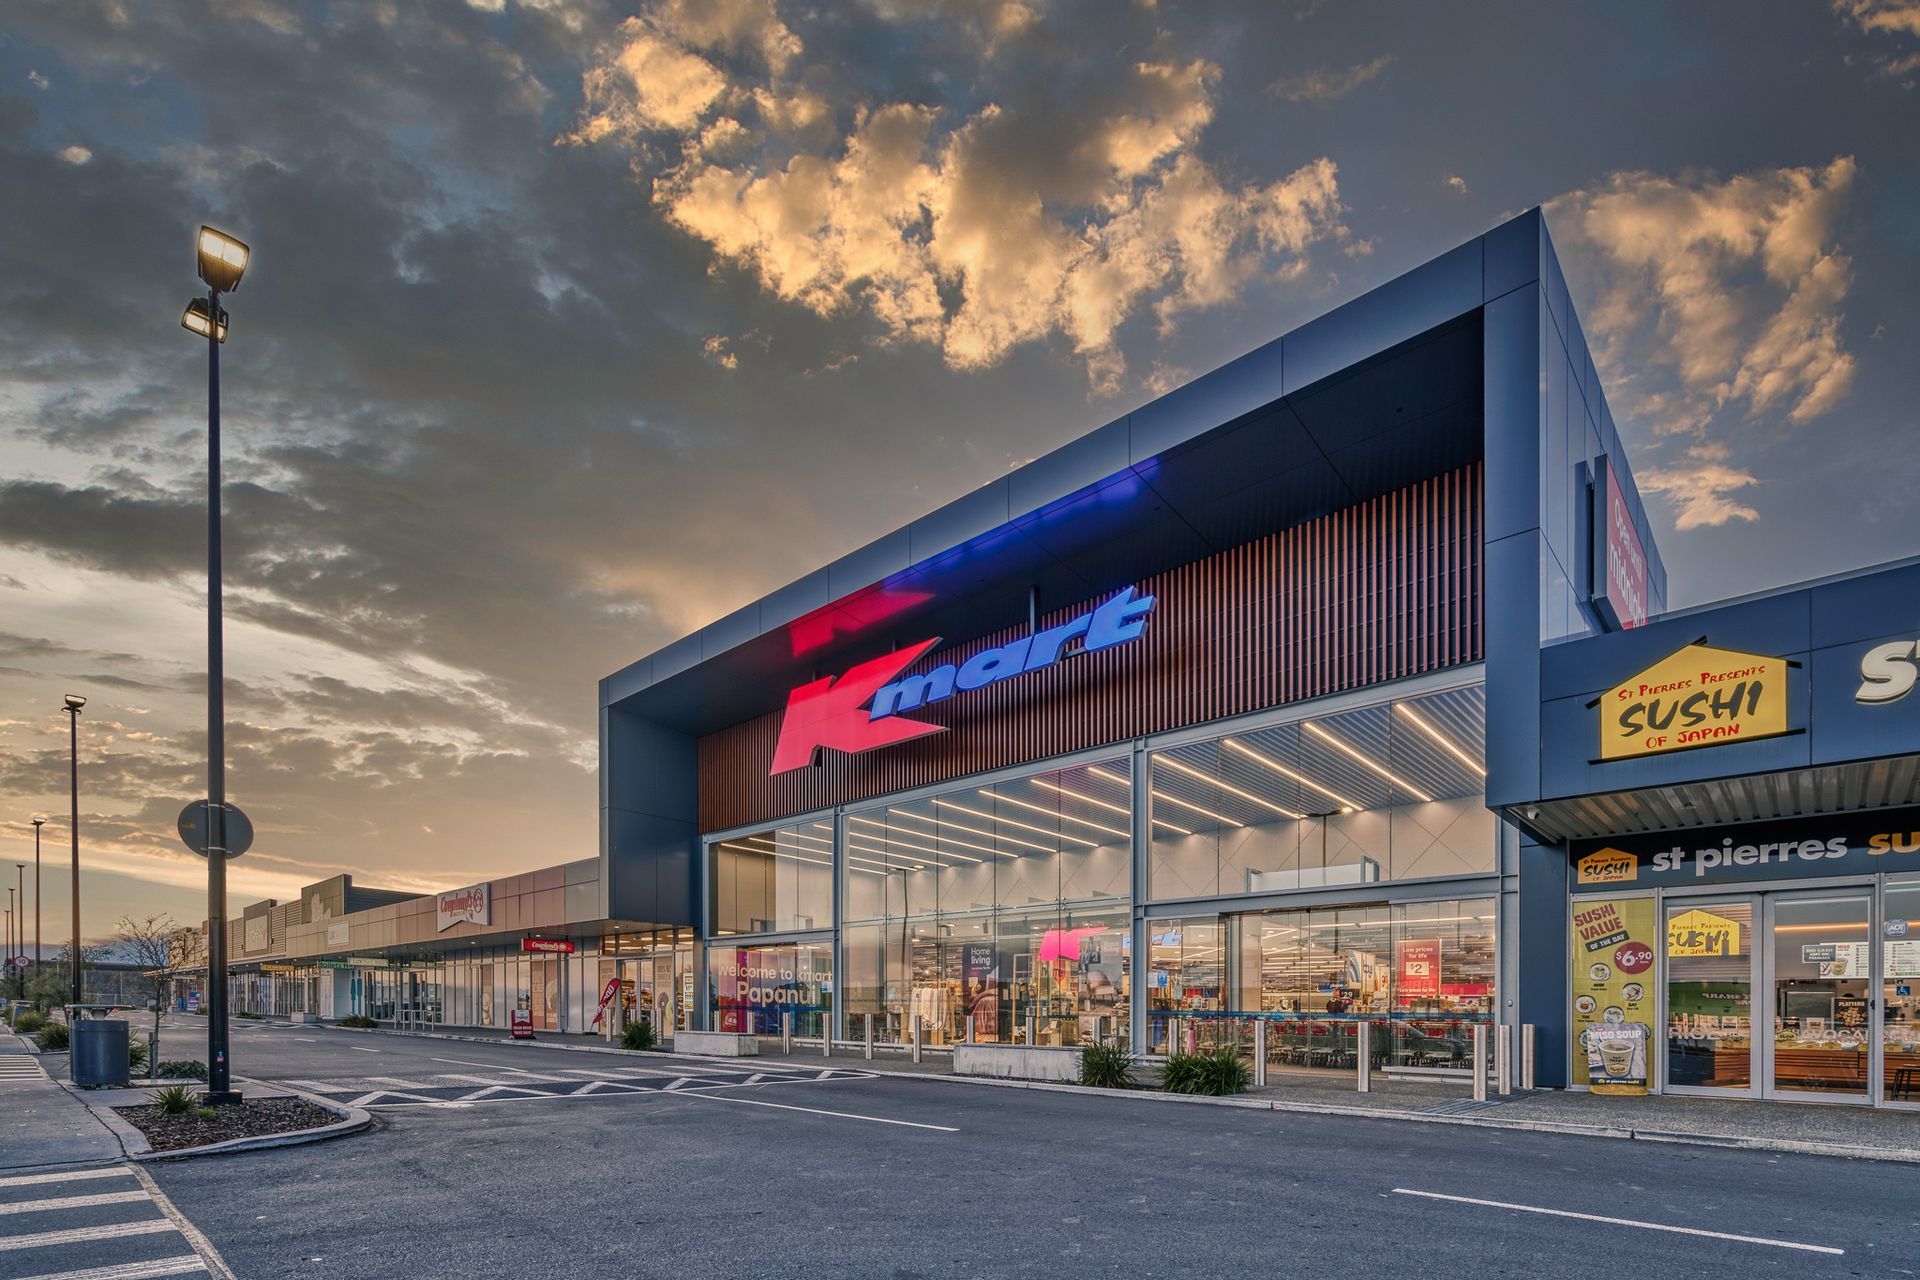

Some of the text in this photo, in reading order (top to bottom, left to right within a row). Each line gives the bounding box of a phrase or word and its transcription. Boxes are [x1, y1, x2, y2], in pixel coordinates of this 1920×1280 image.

[1614, 499, 1642, 582] Open until
[1610, 542, 1645, 628] midnight
[770, 585, 1157, 776] Kmart
[1856, 640, 1920, 704] S
[1619, 680, 1763, 737] SUSHI
[1646, 724, 1740, 749] OF JAPAN
[1652, 846, 1685, 872] st
[1695, 837, 1847, 877] pierres
[1583, 862, 1630, 877] SUSHI
[1574, 903, 1616, 927] SUSHI
[1579, 917, 1623, 940] VALUE
[1600, 939, 1611, 947] THE
[1612, 934, 1625, 942] DAY
[971, 956, 990, 965] living
[1410, 963, 1422, 974] $2
[1616, 951, 1652, 966] $6.90
[719, 963, 832, 982] welcome to kmart
[737, 981, 816, 1007] Papanui
[1590, 1030, 1642, 1039] MISO SOUP
